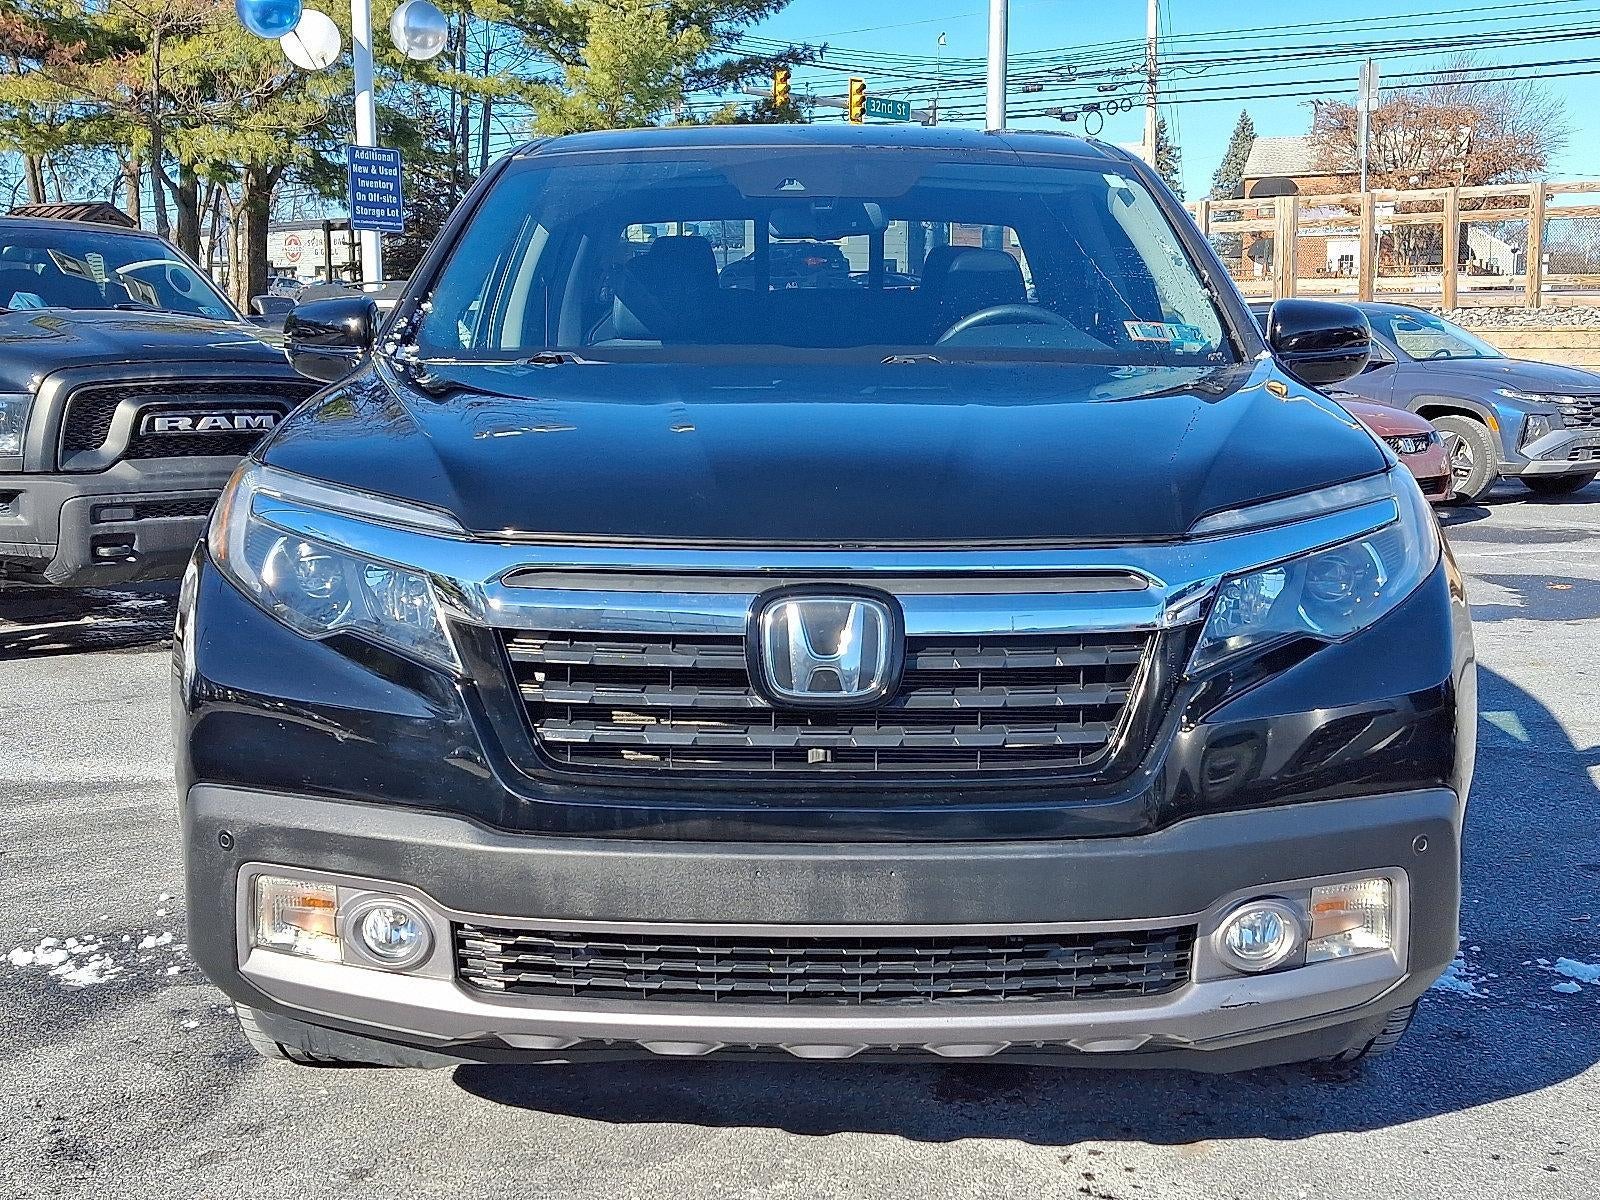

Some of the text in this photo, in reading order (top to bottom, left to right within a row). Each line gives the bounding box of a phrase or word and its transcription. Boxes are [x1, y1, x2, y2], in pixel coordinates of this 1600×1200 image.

[870, 99, 906, 116] 32nd St
[354, 149, 394, 162] Additional
[352, 163, 398, 176] New & Used
[357, 177, 394, 191] Inventory
[355, 191, 397, 204] On Off-site
[355, 205, 400, 218] Storage Lot
[154, 415, 275, 432] RAM
